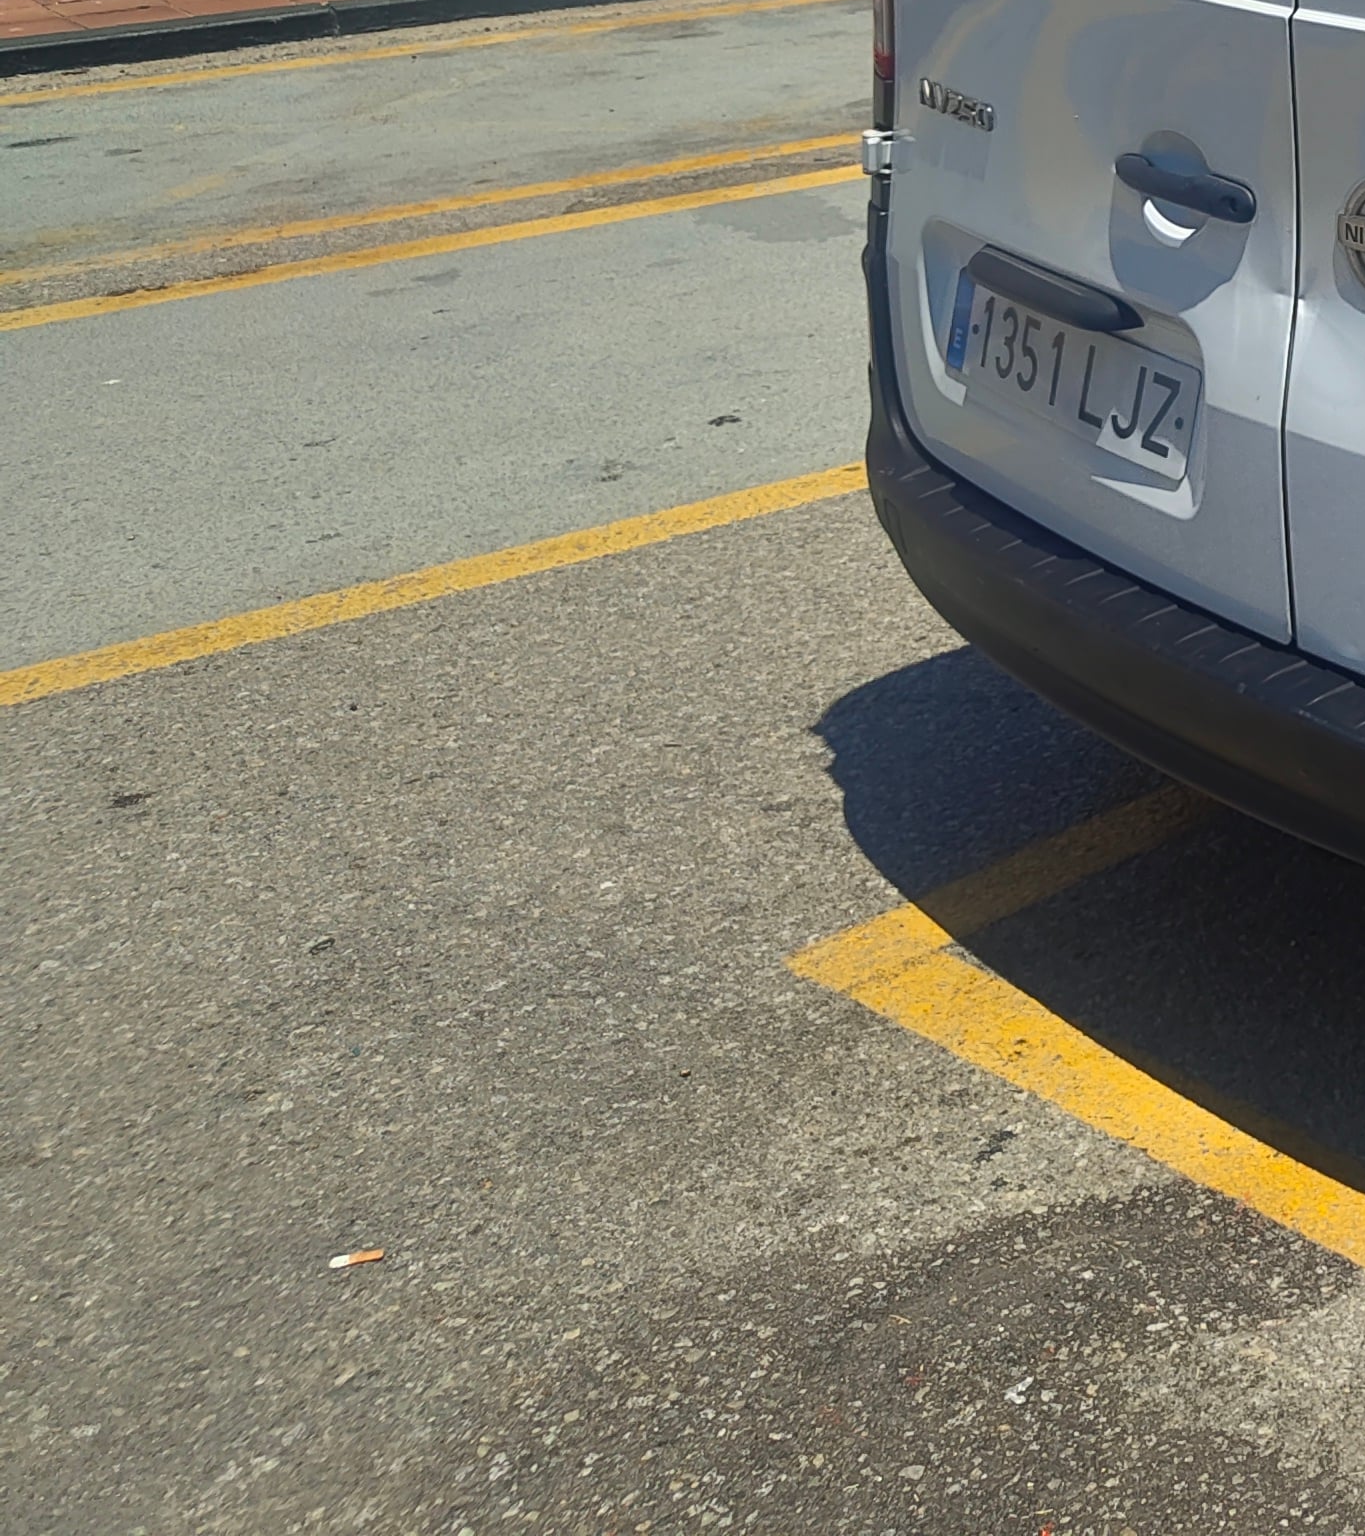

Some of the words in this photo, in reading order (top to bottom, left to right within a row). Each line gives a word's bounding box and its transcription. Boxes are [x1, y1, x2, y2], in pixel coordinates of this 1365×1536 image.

[952, 327, 964, 350] E
[980, 295, 1066, 407] 1351
[1077, 344, 1182, 459] LJZ
